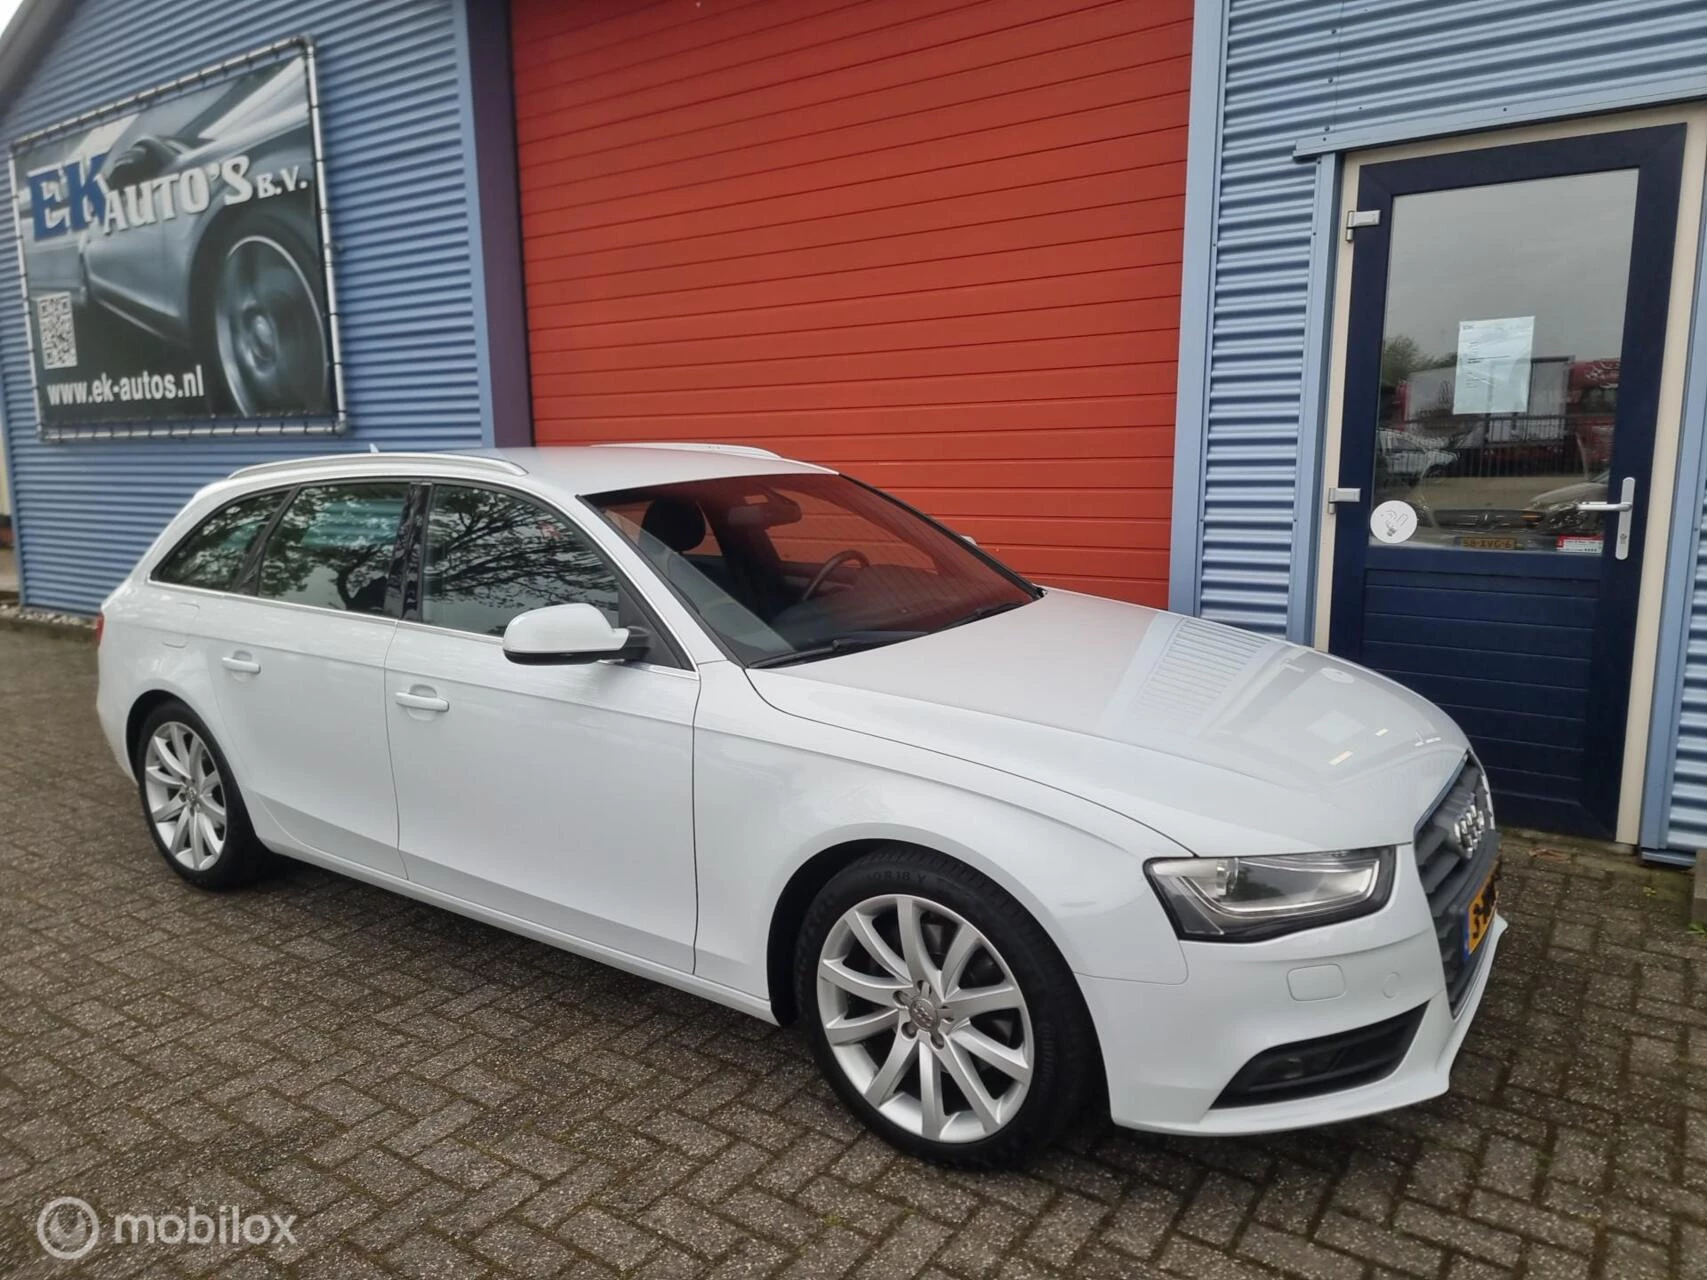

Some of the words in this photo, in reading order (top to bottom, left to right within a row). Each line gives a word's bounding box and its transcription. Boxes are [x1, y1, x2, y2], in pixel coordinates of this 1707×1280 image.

[27, 152, 109, 242] EK
[103, 154, 253, 236] AUTO'S
[255, 166, 309, 200] B.V.
[46, 363, 205, 406] www.ek-autos.nl
